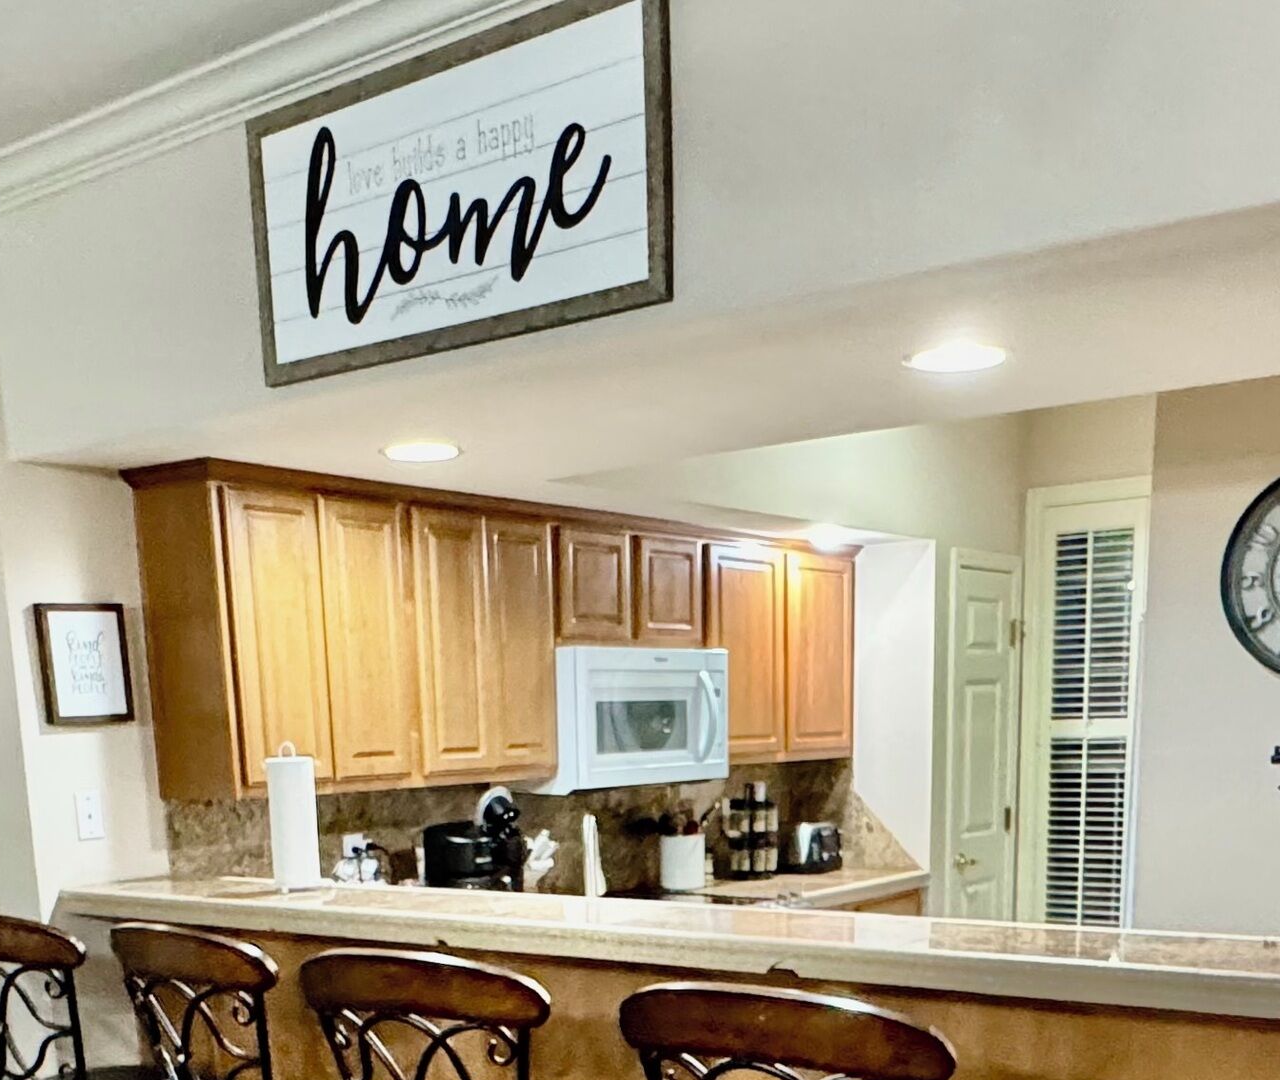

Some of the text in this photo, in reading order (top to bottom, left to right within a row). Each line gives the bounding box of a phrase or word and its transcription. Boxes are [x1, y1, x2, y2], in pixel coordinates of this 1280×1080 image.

[392, 134, 446, 183] builds
[455, 136, 467, 161] a
[476, 113, 536, 159] happy
[304, 123, 613, 325] home
